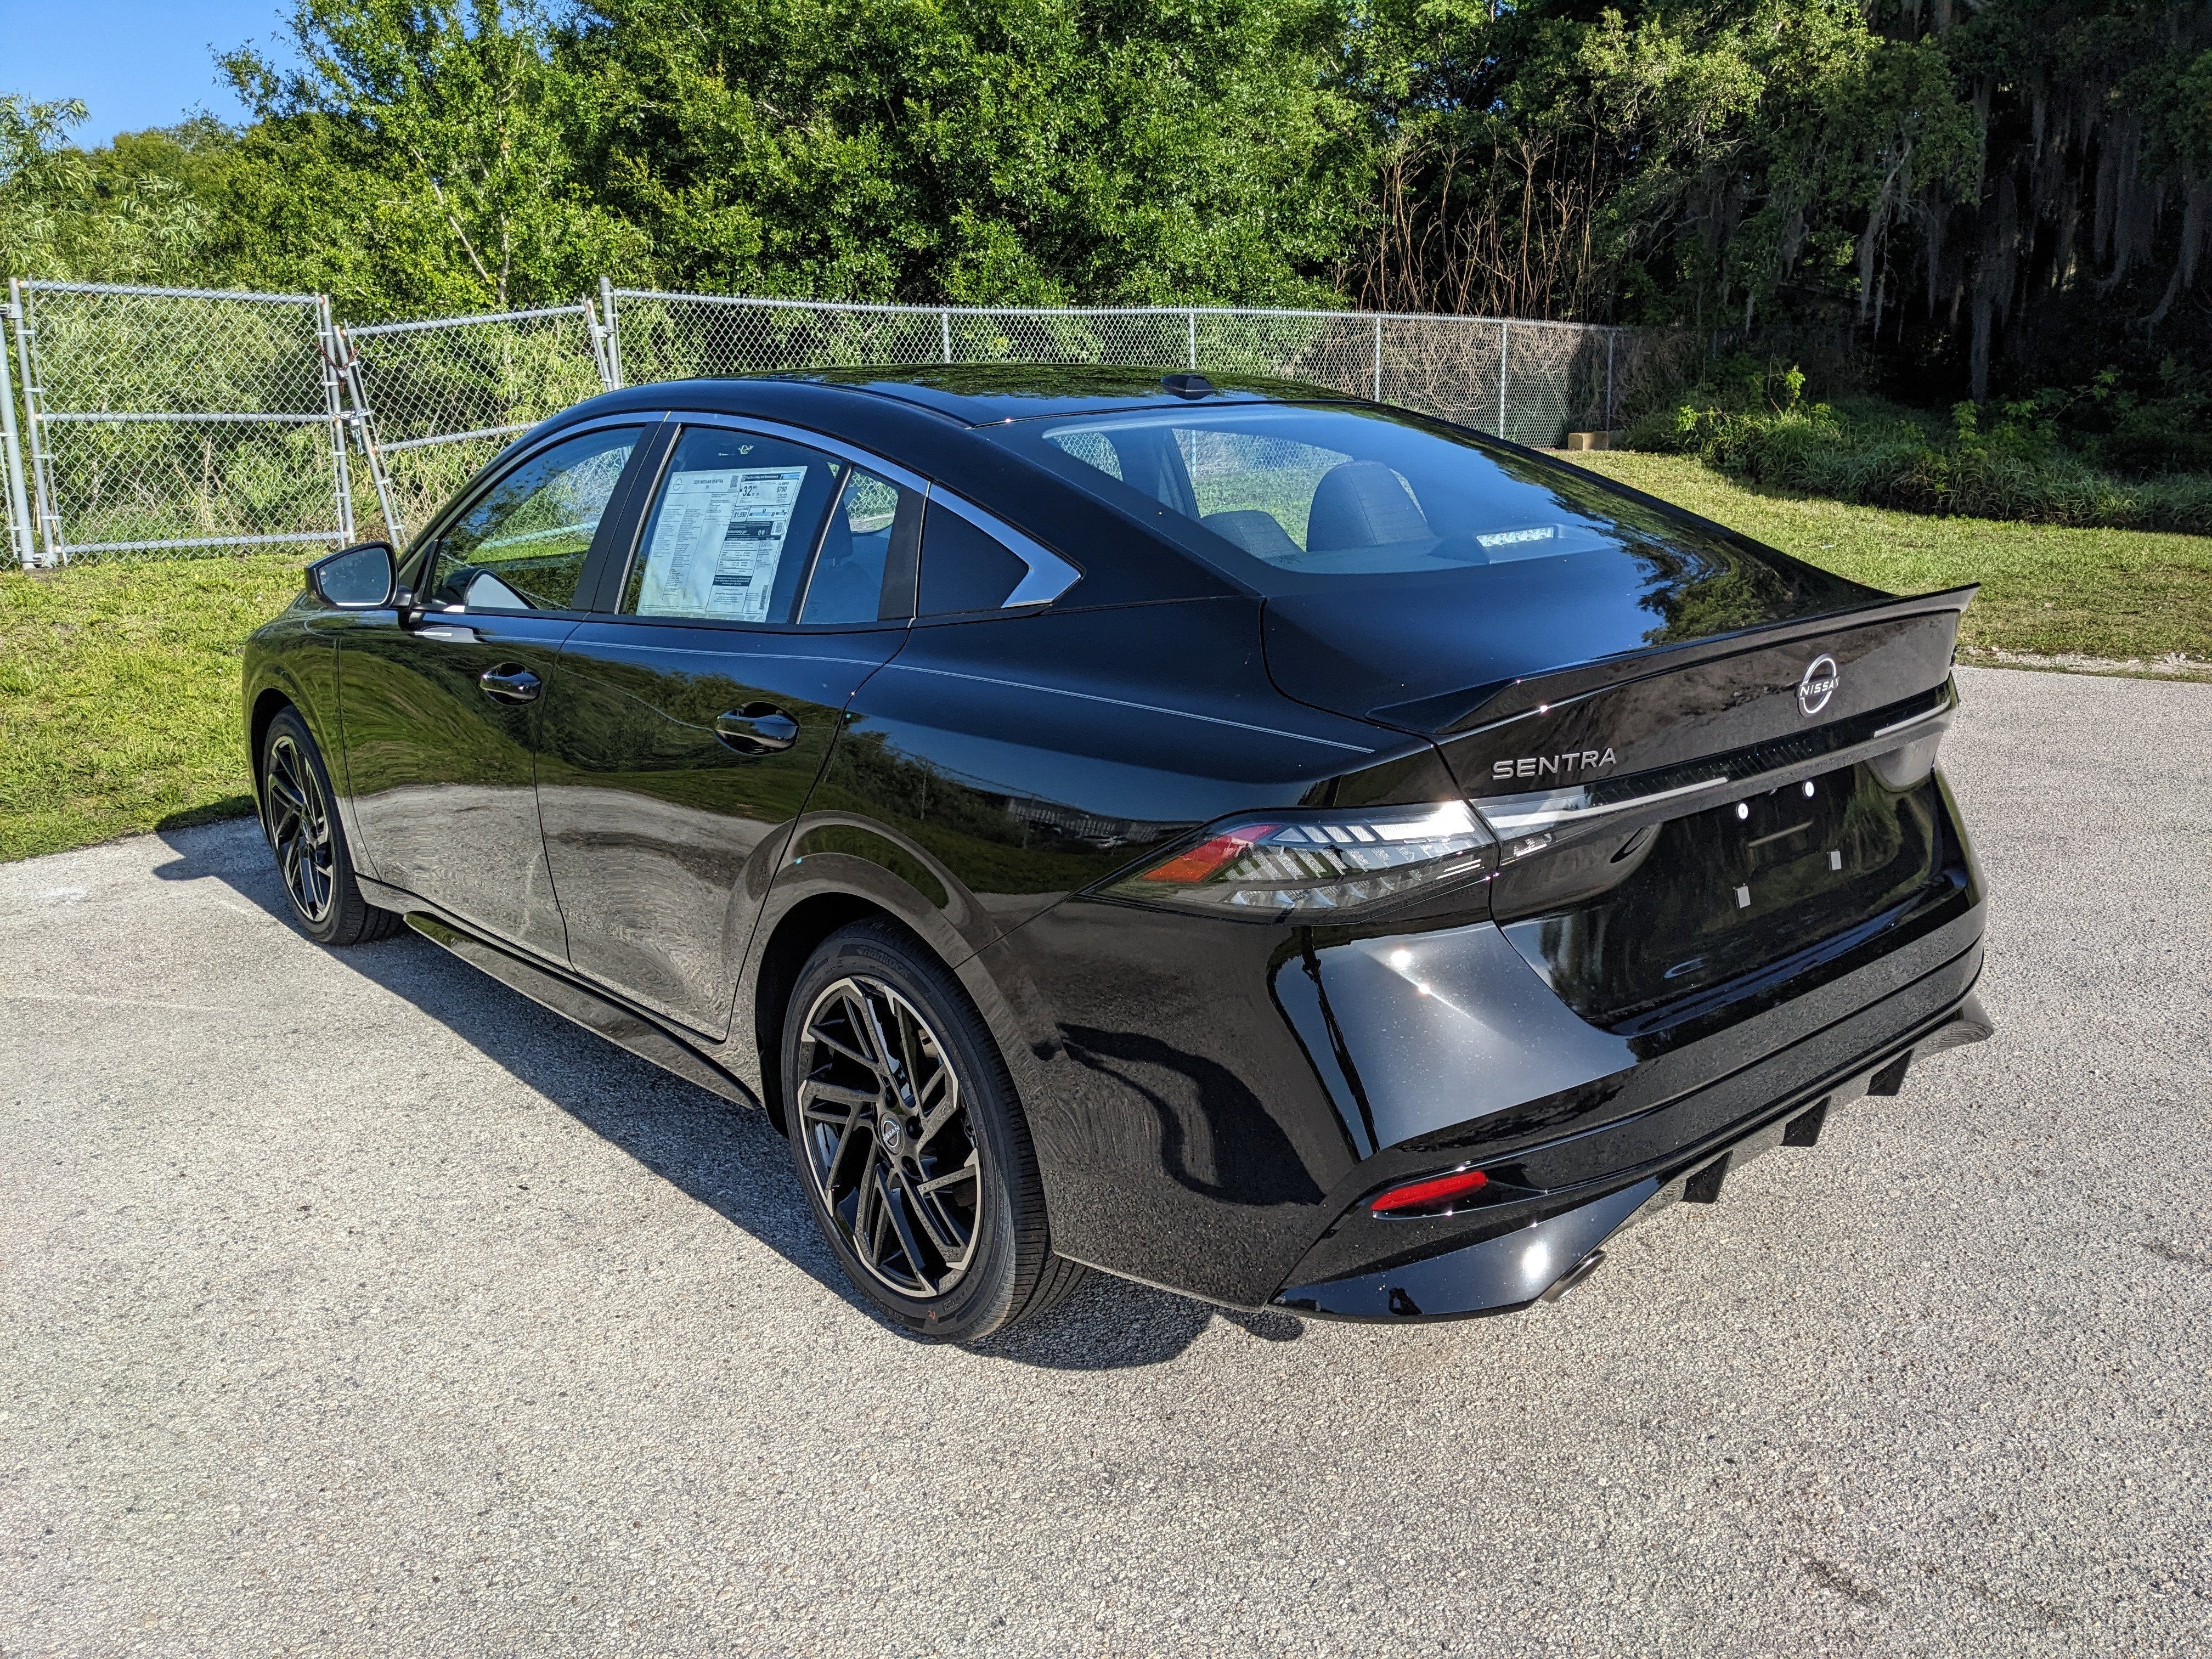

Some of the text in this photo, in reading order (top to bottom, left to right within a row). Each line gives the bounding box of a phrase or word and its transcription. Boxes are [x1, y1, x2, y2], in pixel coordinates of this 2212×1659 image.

[742, 486, 752, 496] 32
[1799, 678, 1838, 696] NISSAN
[1492, 747, 1617, 780] SENTRA
